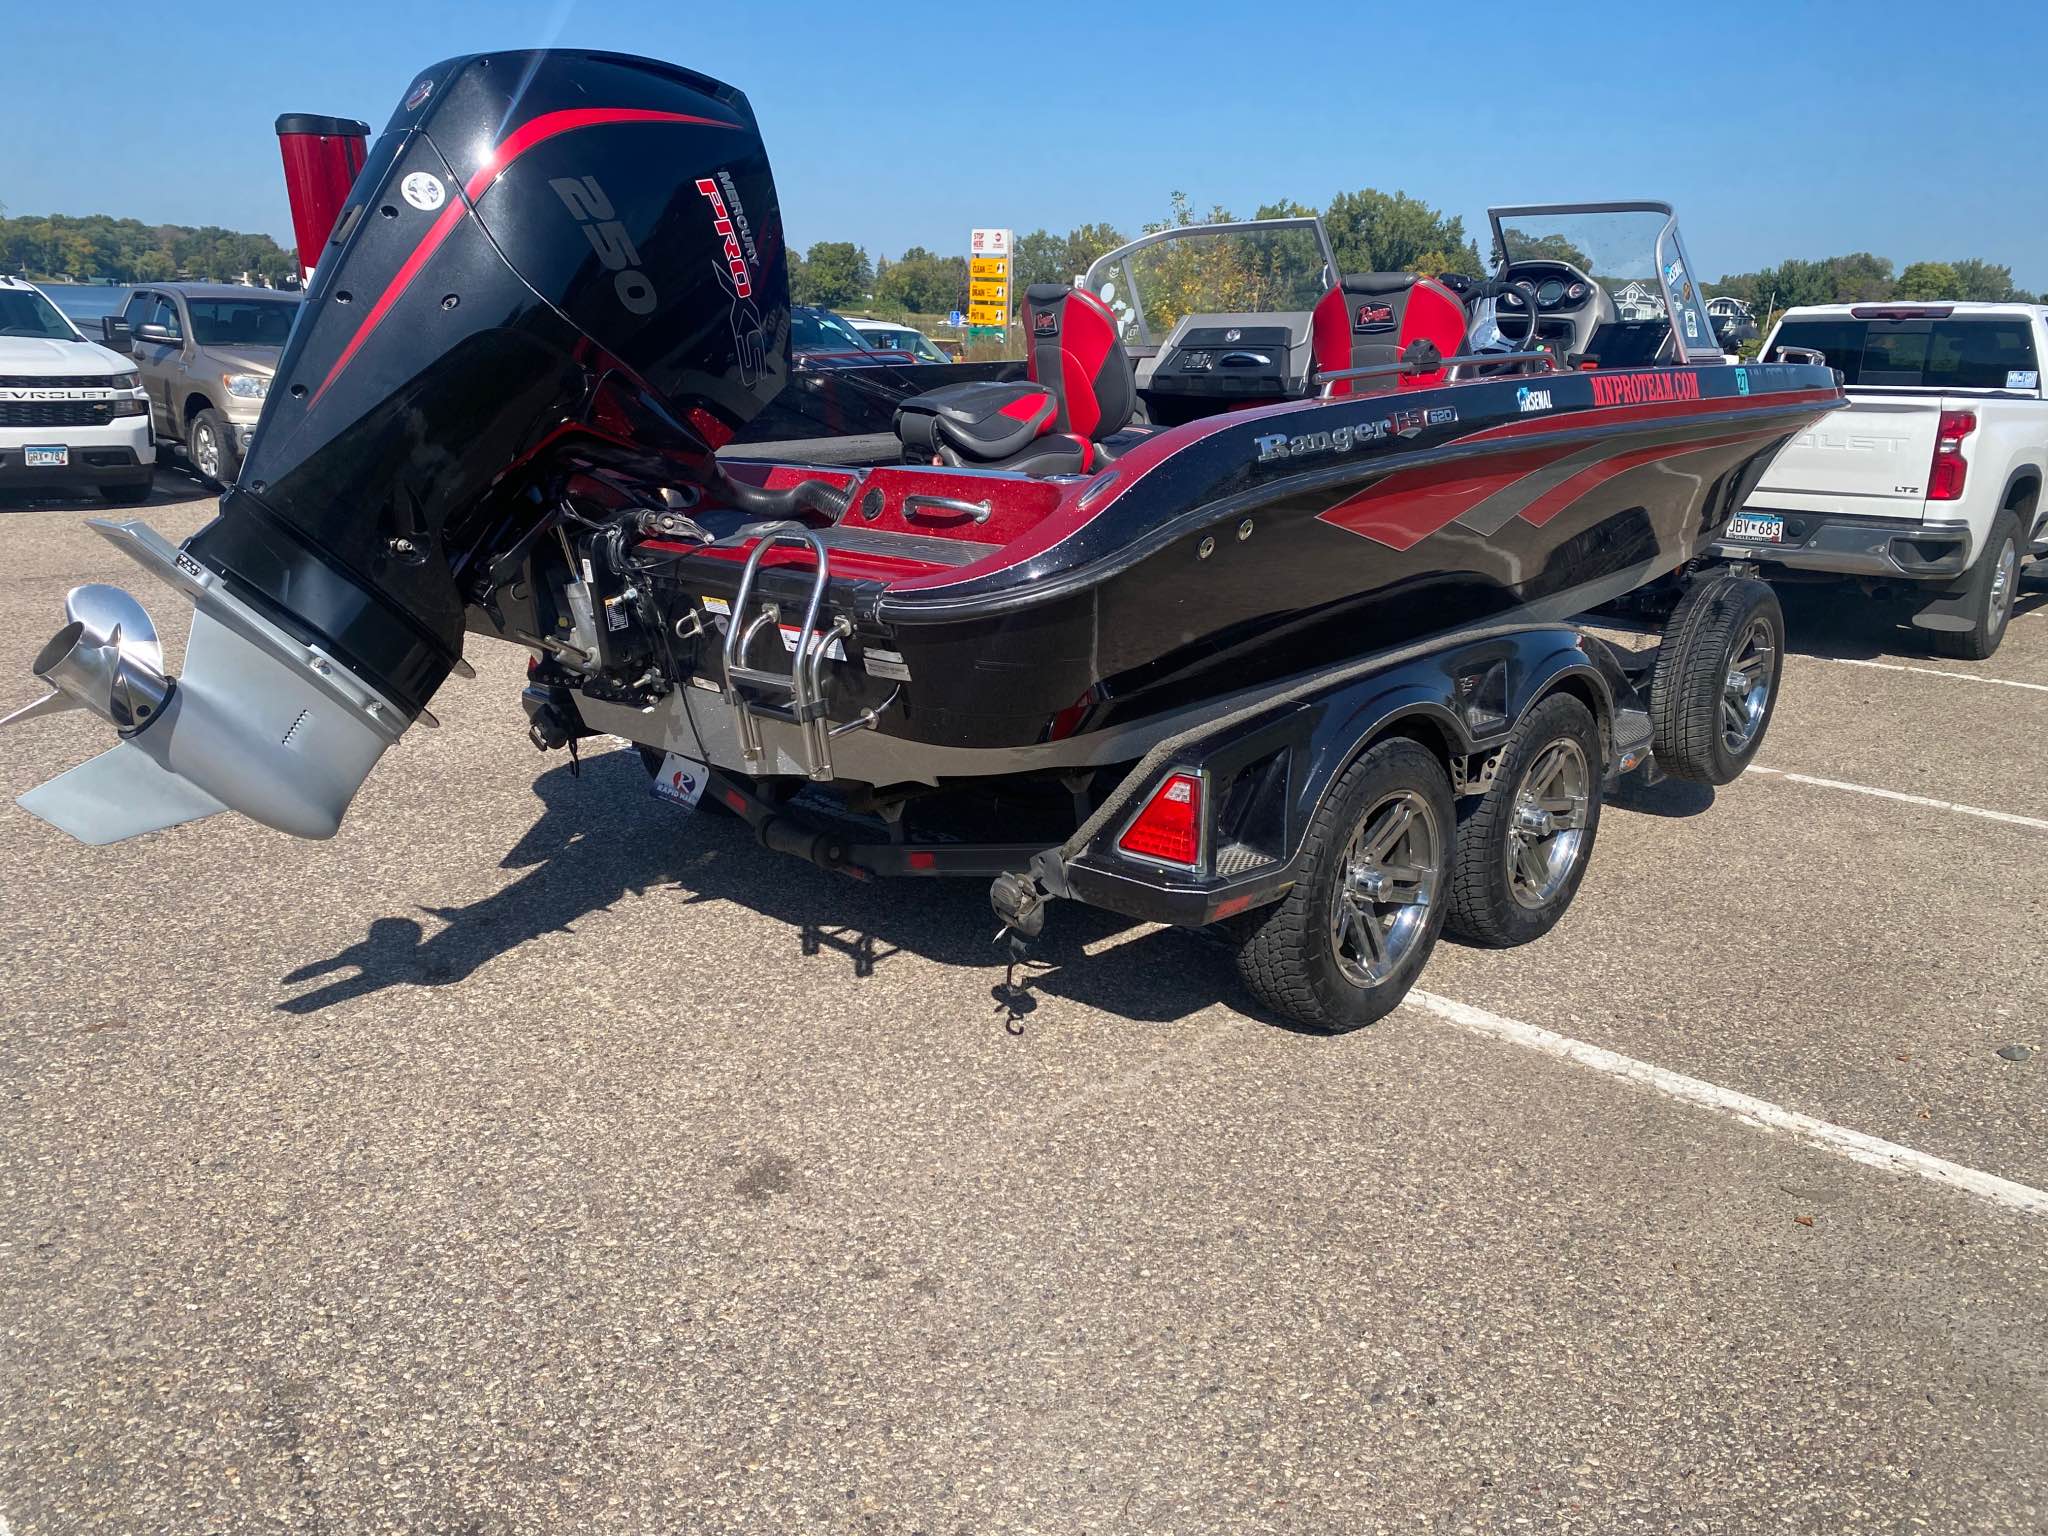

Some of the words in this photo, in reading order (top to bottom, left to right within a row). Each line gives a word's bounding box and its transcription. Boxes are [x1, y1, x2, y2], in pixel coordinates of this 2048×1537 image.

[549, 175, 657, 315] 250
[695, 178, 752, 299] PRO
[717, 171, 760, 267] MERCURY
[1590, 372, 1700, 406] MNPROTEAM.COM
[1254, 418, 1392, 462] Ranger
[1430, 409, 1452, 423] 620
[1894, 486, 1919, 494] LTZ
[1758, 521, 1781, 536] 683
